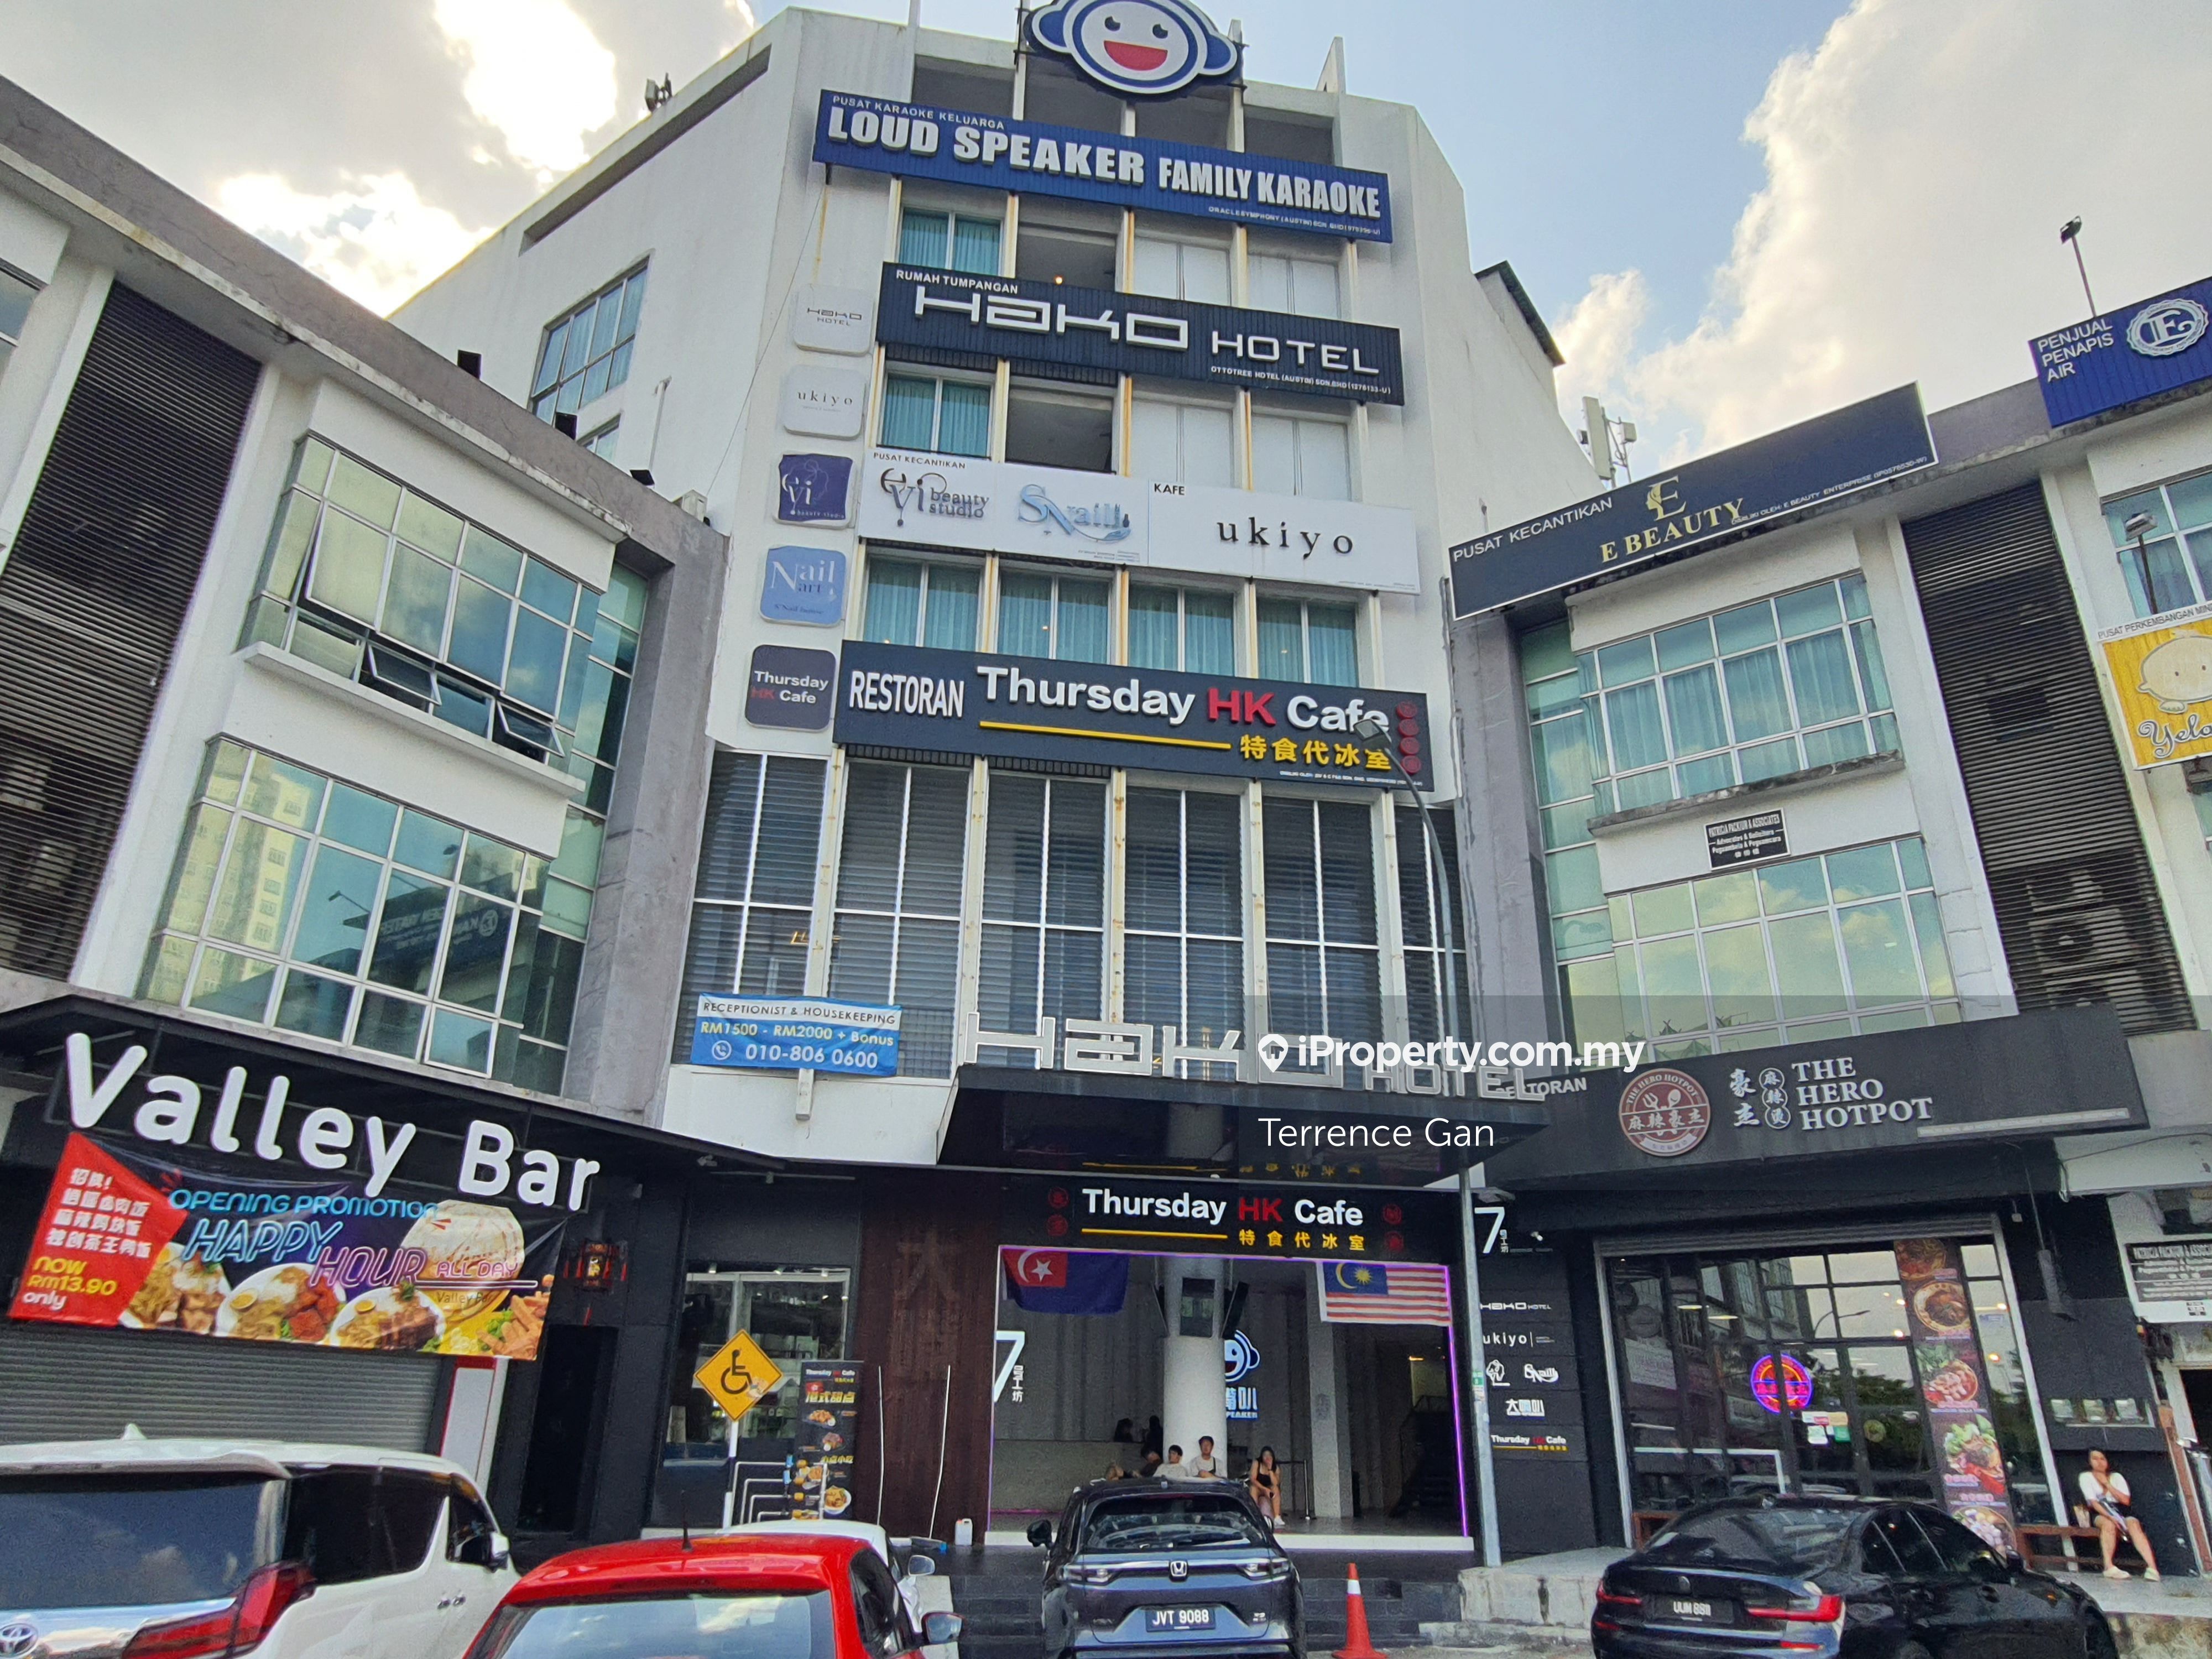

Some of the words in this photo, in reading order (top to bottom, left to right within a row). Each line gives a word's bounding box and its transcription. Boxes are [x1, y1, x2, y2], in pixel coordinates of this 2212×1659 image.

[833, 96, 872, 110] PUSAT
[875, 102, 934, 119] KARAOKE
[940, 112, 1005, 130] KELUARGA
[828, 106, 939, 157] LOUD
[953, 126, 1145, 186] SPEAKER
[1159, 157, 1253, 200] FAMILY
[1258, 171, 1381, 218] KARAOKE
[896, 269, 940, 284] RUMAH
[942, 276, 1019, 295] TUMPANGAN
[817, 317, 851, 326] HOTEL
[2037, 319, 2114, 352] PENJUAL
[1212, 330, 1380, 375] HOTEL
[2042, 332, 2115, 367] PENAPIS
[1255, 371, 1280, 380] HOTEL
[2047, 362, 2076, 383] AIR
[797, 390, 853, 407] ukiyo
[874, 452, 902, 462] PUSAT
[905, 456, 966, 469] KECANTIKAN
[930, 487, 989, 509] beauty
[1154, 483, 1185, 495] KAFE
[1790, 492, 1821, 506] BEAUTY
[1823, 474, 1872, 495] ENTERPRISE
[929, 502, 985, 519] studio
[1217, 517, 1354, 560] ukiyo
[1453, 535, 1504, 562] PUSAT
[1509, 497, 1613, 543] KECANTIKAN
[1599, 541, 1618, 563] E
[1623, 498, 1744, 556] BEAUTY
[771, 560, 836, 592] Nail
[2098, 625, 2124, 639] PUSAT
[2125, 609, 2195, 633] PERKEMBANGAN
[754, 671, 829, 691] Thursday
[779, 690, 817, 704] Cafe
[849, 670, 964, 718] RESTORAN
[977, 666, 1196, 726] Thursday
[1208, 687, 1277, 726] HK
[1287, 695, 1390, 733] Cafe
[703, 1002, 786, 1015] RECEPTIONIST
[791, 1006, 798, 1015] &
[804, 1007, 896, 1025] HOUSEKEEPING
[700, 1021, 758, 1036] RM1500
[773, 1024, 833, 1040] RM2000
[851, 1031, 894, 1047] Bonus
[745, 1044, 825, 1063] 010-806
[832, 1051, 878, 1068] 0600
[1792, 1057, 1856, 1082] THE
[1626, 1086, 1640, 1105] THE
[1639, 1074, 1662, 1089] HERO
[1665, 1074, 1698, 1097] HOTPOT
[1796, 1079, 1884, 1107] HERO
[65, 1032, 417, 1198] Valley
[457, 1119, 601, 1212] Bar
[1799, 1097, 1933, 1131] HOTPOT
[169, 1188, 291, 1214] OPENING
[1082, 1188, 1227, 1225] Thursday
[1238, 1197, 1284, 1222] HK
[1294, 1199, 1364, 1227] Cafe
[181, 1218, 343, 1264] HAPPY
[1474, 1207, 1505, 1254] 7
[310, 1245, 428, 1287] HOUR
[436, 1261, 473, 1277] ALL
[477, 1261, 519, 1277] DAY
[22, 1290, 67, 1311] only
[1483, 1332, 1527, 1347] ukiyo
[994, 1330, 1025, 1403] 7
[1491, 1434, 1530, 1446] Thursday
[1546, 1435, 1567, 1444] Cafe
[1152, 1610, 1174, 1626] JVT
[1179, 1609, 1209, 1624] 9088
